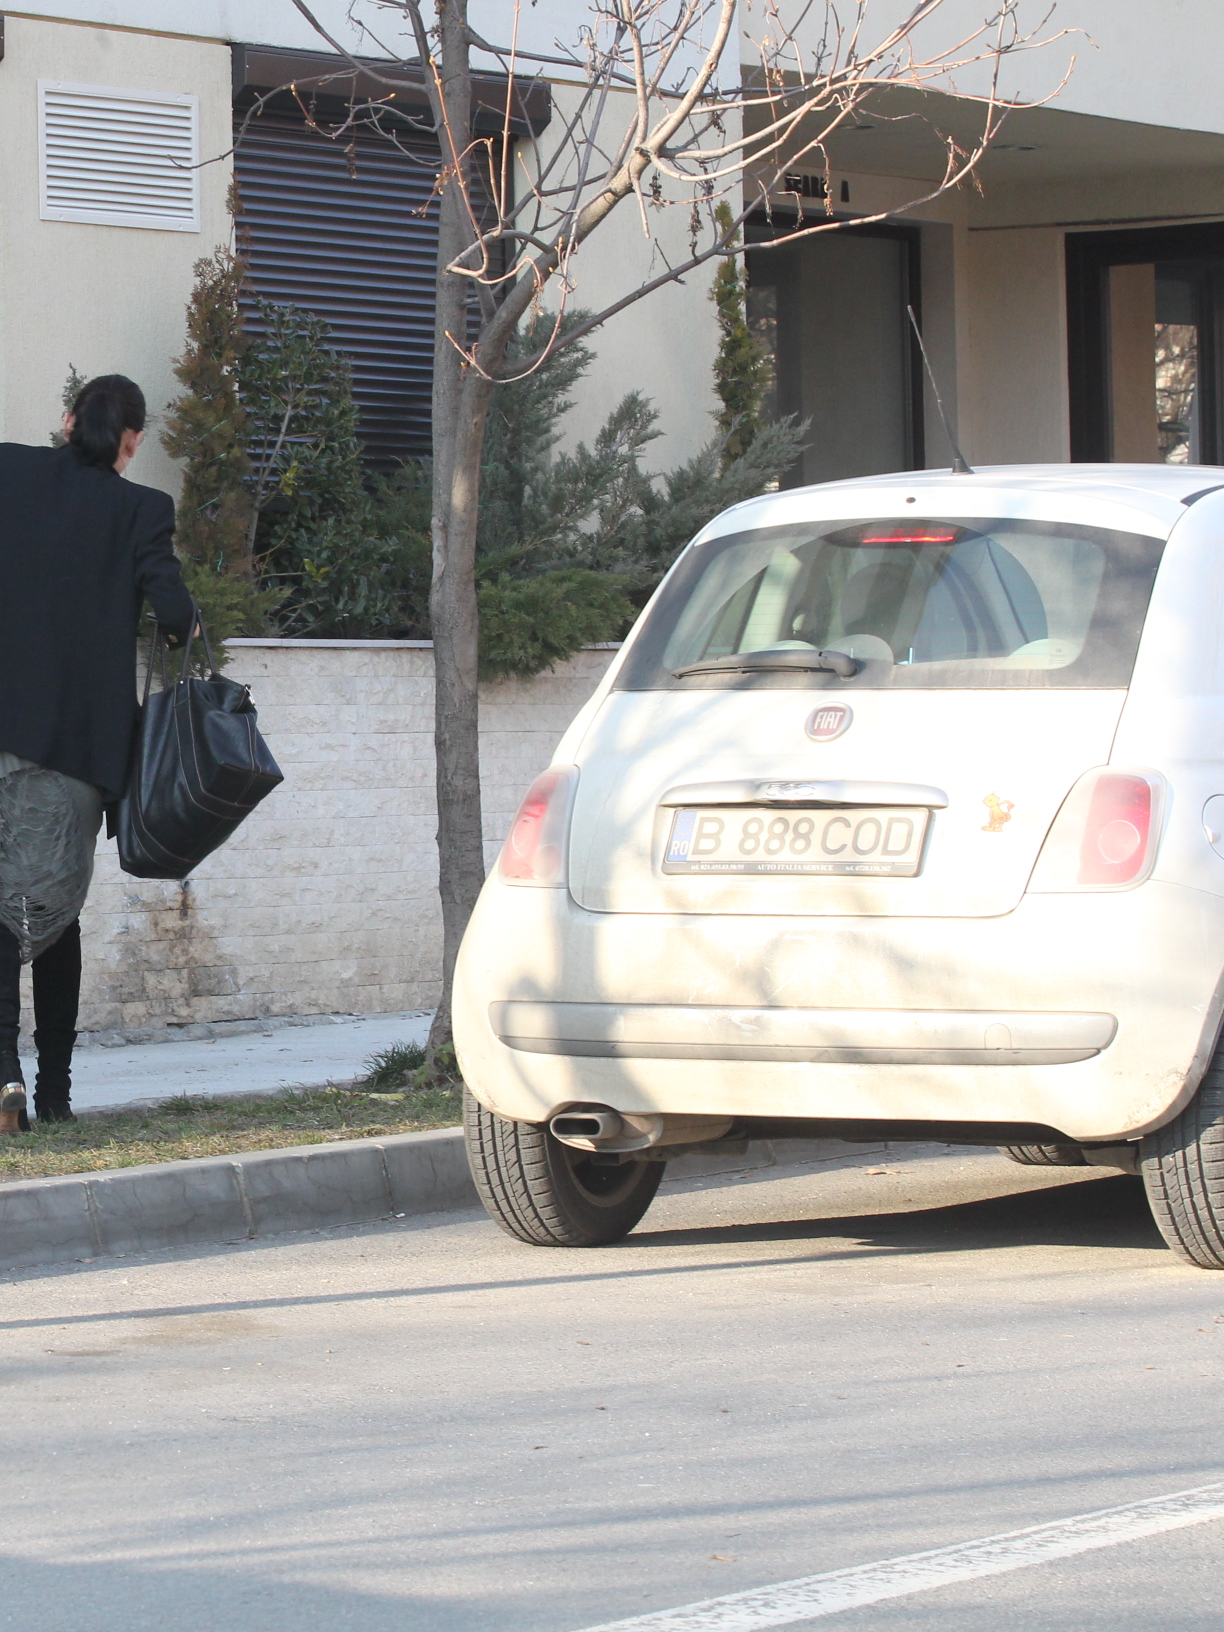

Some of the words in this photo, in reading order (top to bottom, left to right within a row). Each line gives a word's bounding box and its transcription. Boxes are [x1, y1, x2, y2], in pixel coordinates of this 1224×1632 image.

[813, 711, 844, 730] FIAT
[691, 816, 725, 856] B
[738, 816, 815, 856] 888
[821, 816, 914, 856] COD
[669, 840, 688, 856] RO
